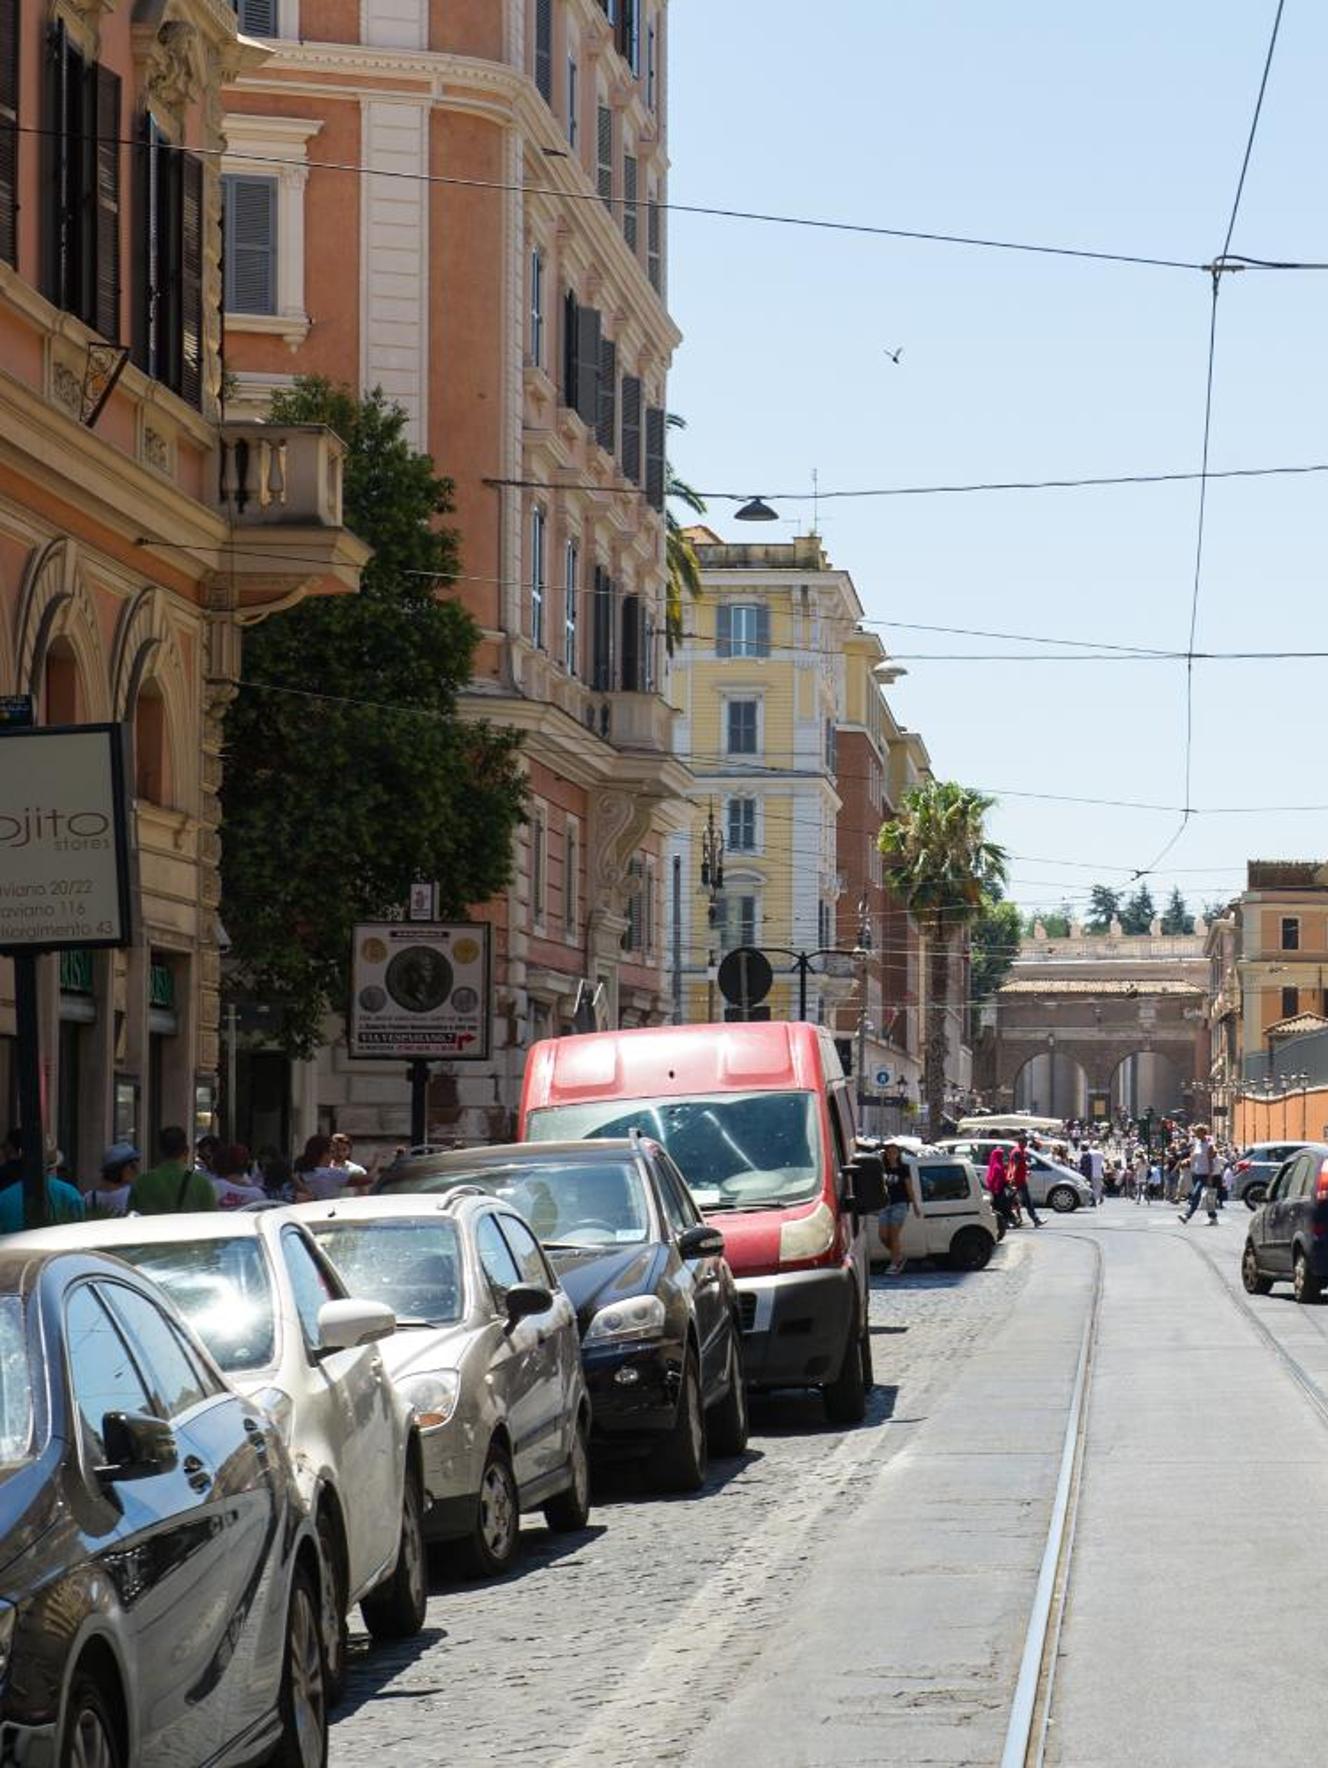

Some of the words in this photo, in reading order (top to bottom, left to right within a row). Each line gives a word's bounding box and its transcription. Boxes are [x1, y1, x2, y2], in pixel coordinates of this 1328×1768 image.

[54, 836, 111, 851] stores
[0, 881, 46, 898] viano
[51, 880, 94, 896] 20/22
[60, 900, 86, 916] 116
[96, 920, 114, 936] 43
